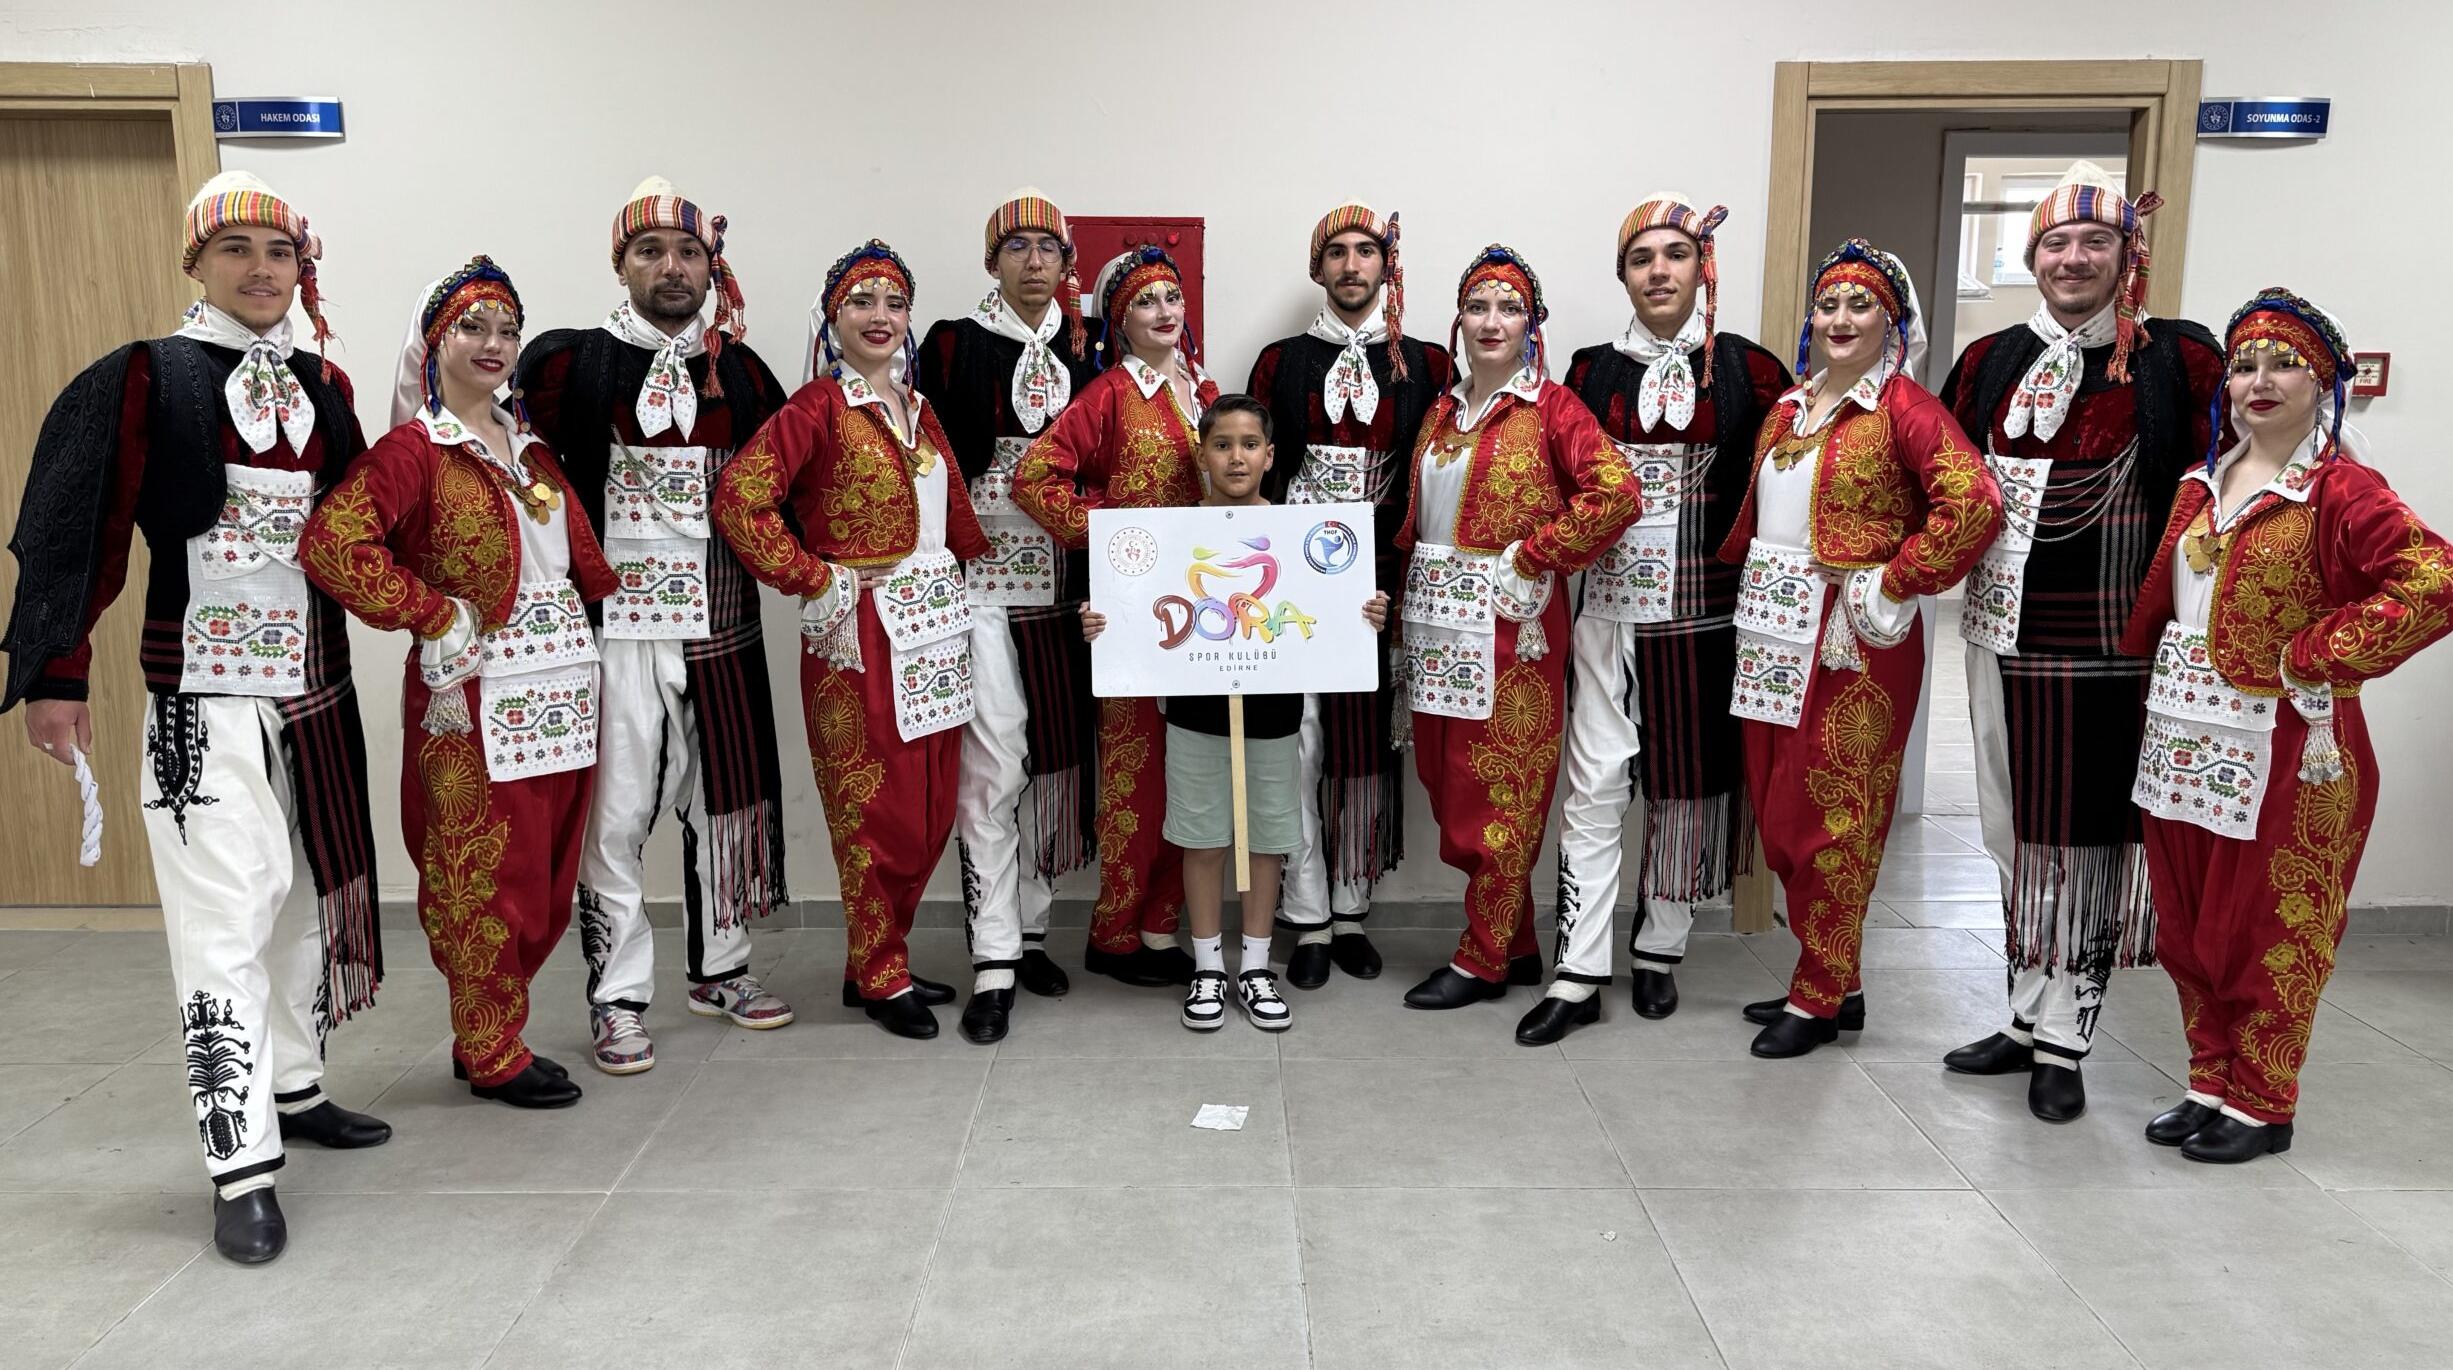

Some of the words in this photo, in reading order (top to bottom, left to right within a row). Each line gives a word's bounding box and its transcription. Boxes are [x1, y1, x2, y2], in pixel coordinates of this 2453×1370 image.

[260, 113, 291, 122] HAKEM
[292, 113, 321, 123] ODASI
[2246, 113, 2290, 123] SOYUNMA
[1153, 593, 1316, 650] DORA
[1189, 652, 1220, 662] SPOR
[1228, 649, 1277, 661] KULÜBÜ
[1219, 664, 1258, 672] EDİRNE
